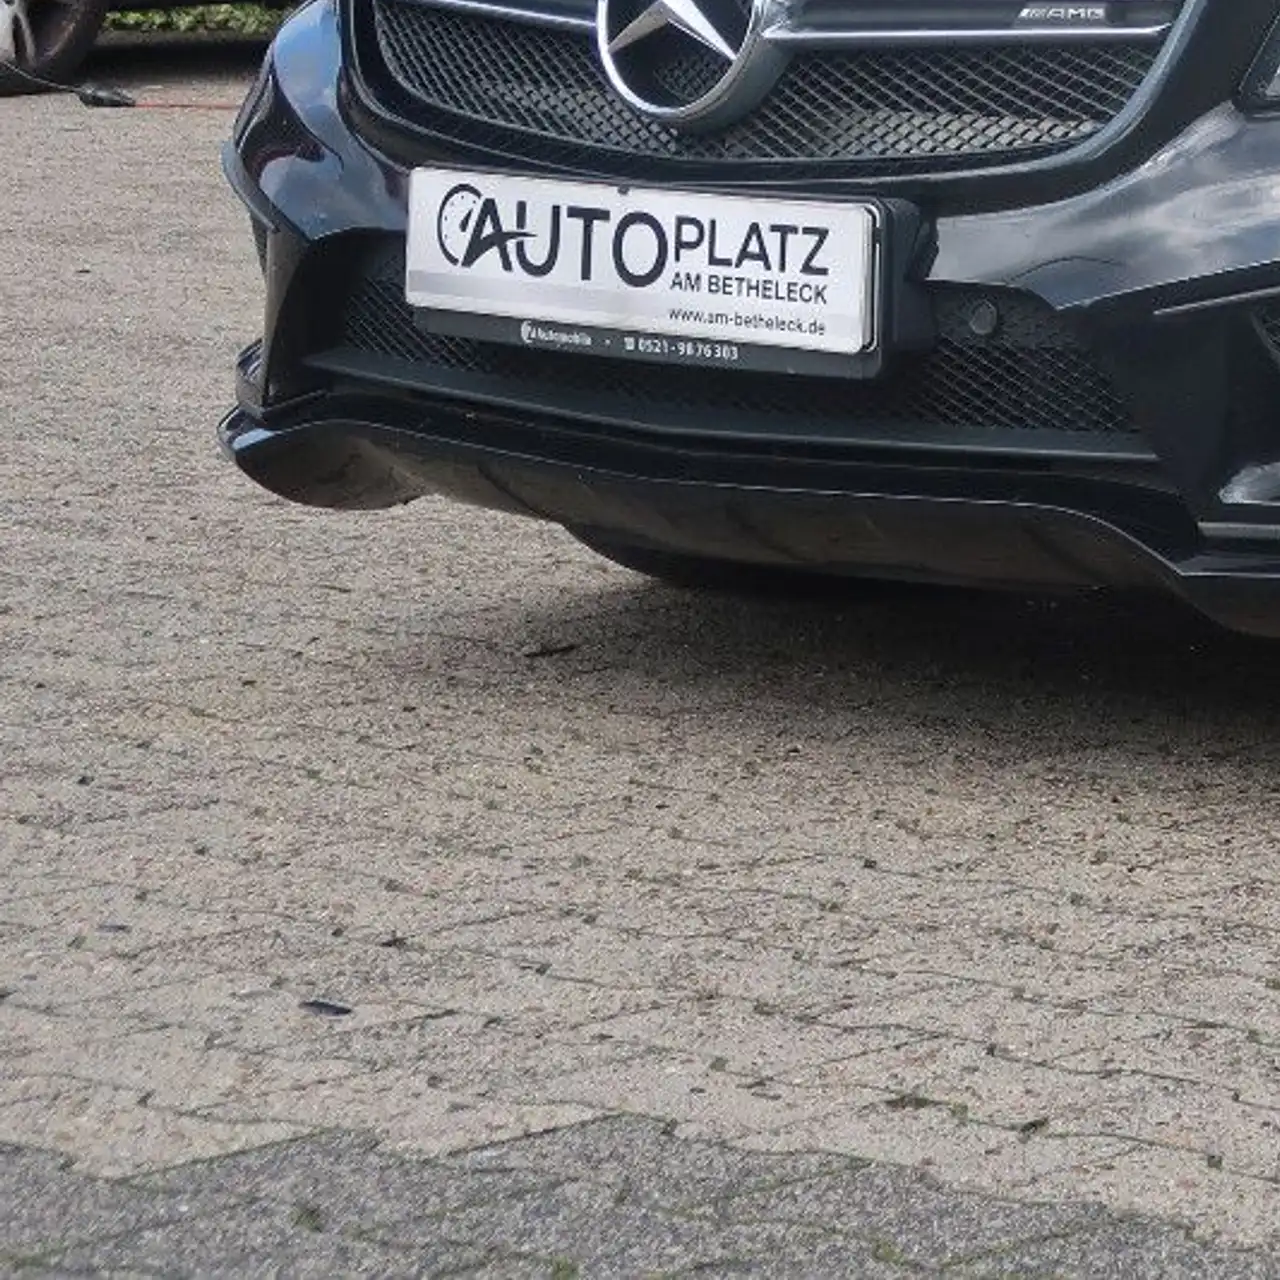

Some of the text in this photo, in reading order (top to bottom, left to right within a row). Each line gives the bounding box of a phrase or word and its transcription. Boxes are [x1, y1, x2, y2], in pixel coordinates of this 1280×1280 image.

[670, 272, 828, 305] AM BETHELECK
[668, 308, 826, 336] www.am-betheleck.de
